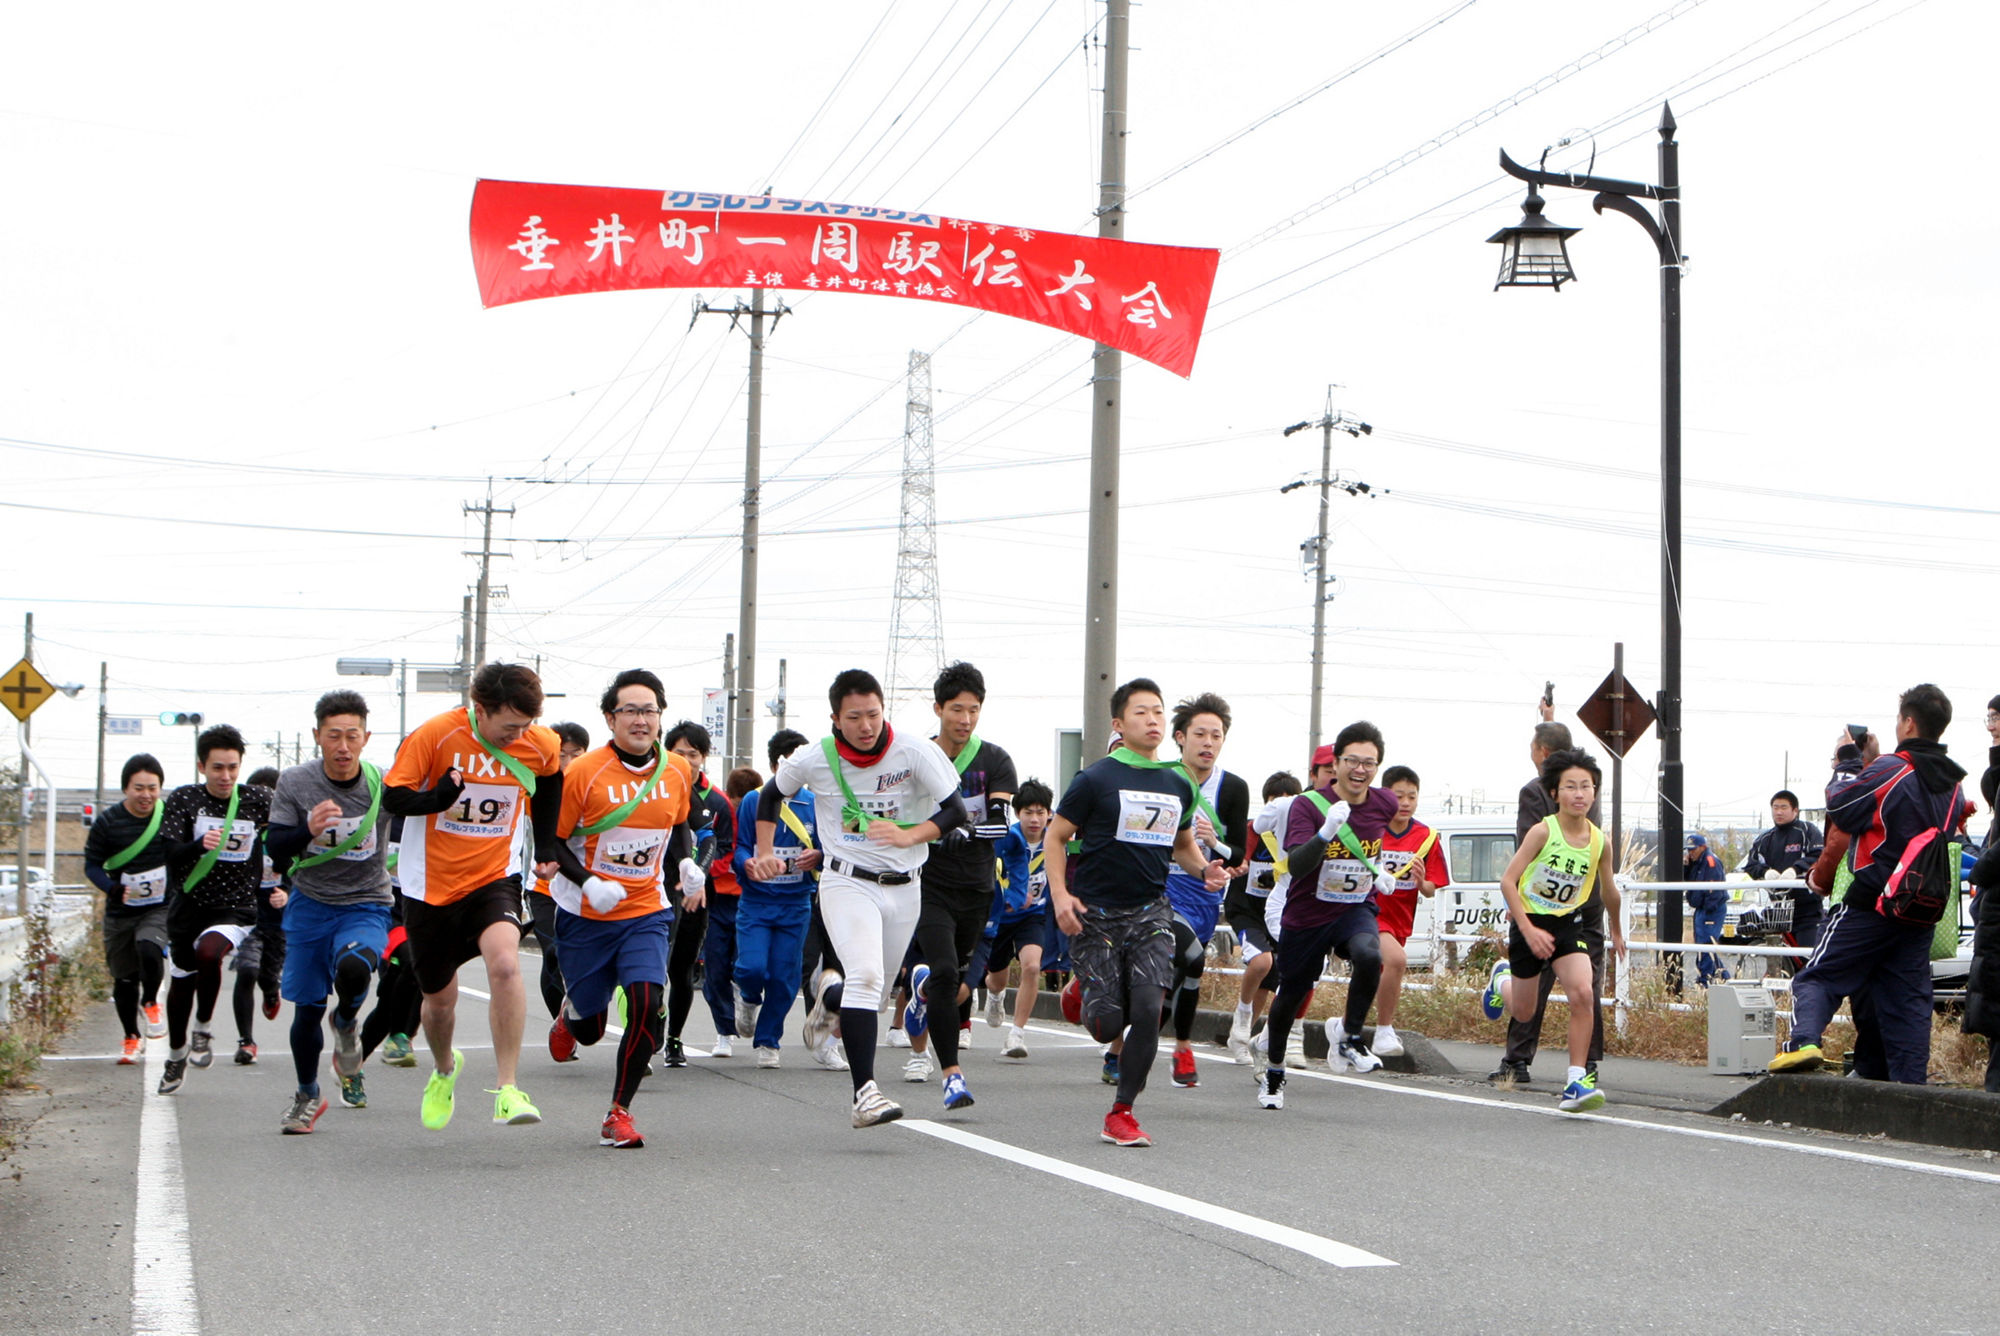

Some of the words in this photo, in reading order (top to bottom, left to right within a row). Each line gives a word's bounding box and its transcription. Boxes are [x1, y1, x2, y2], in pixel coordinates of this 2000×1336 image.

[508, 213, 1172, 328] 垂井町一周駅伝大会
[744, 270, 785, 286] 主催
[802, 273, 957, 298] 垂井町体育協会
[453, 752, 514, 778] LIXI
[608, 780, 669, 804] LIXIL
[457, 798, 499, 824] 19
[1145, 806, 1161, 830] 7
[611, 839, 649, 852] LIXIL
[139, 881, 153, 897] 3
[1342, 874, 1358, 892] 5
[1540, 879, 1575, 902] 30
[1454, 908, 1507, 925] DUSK
